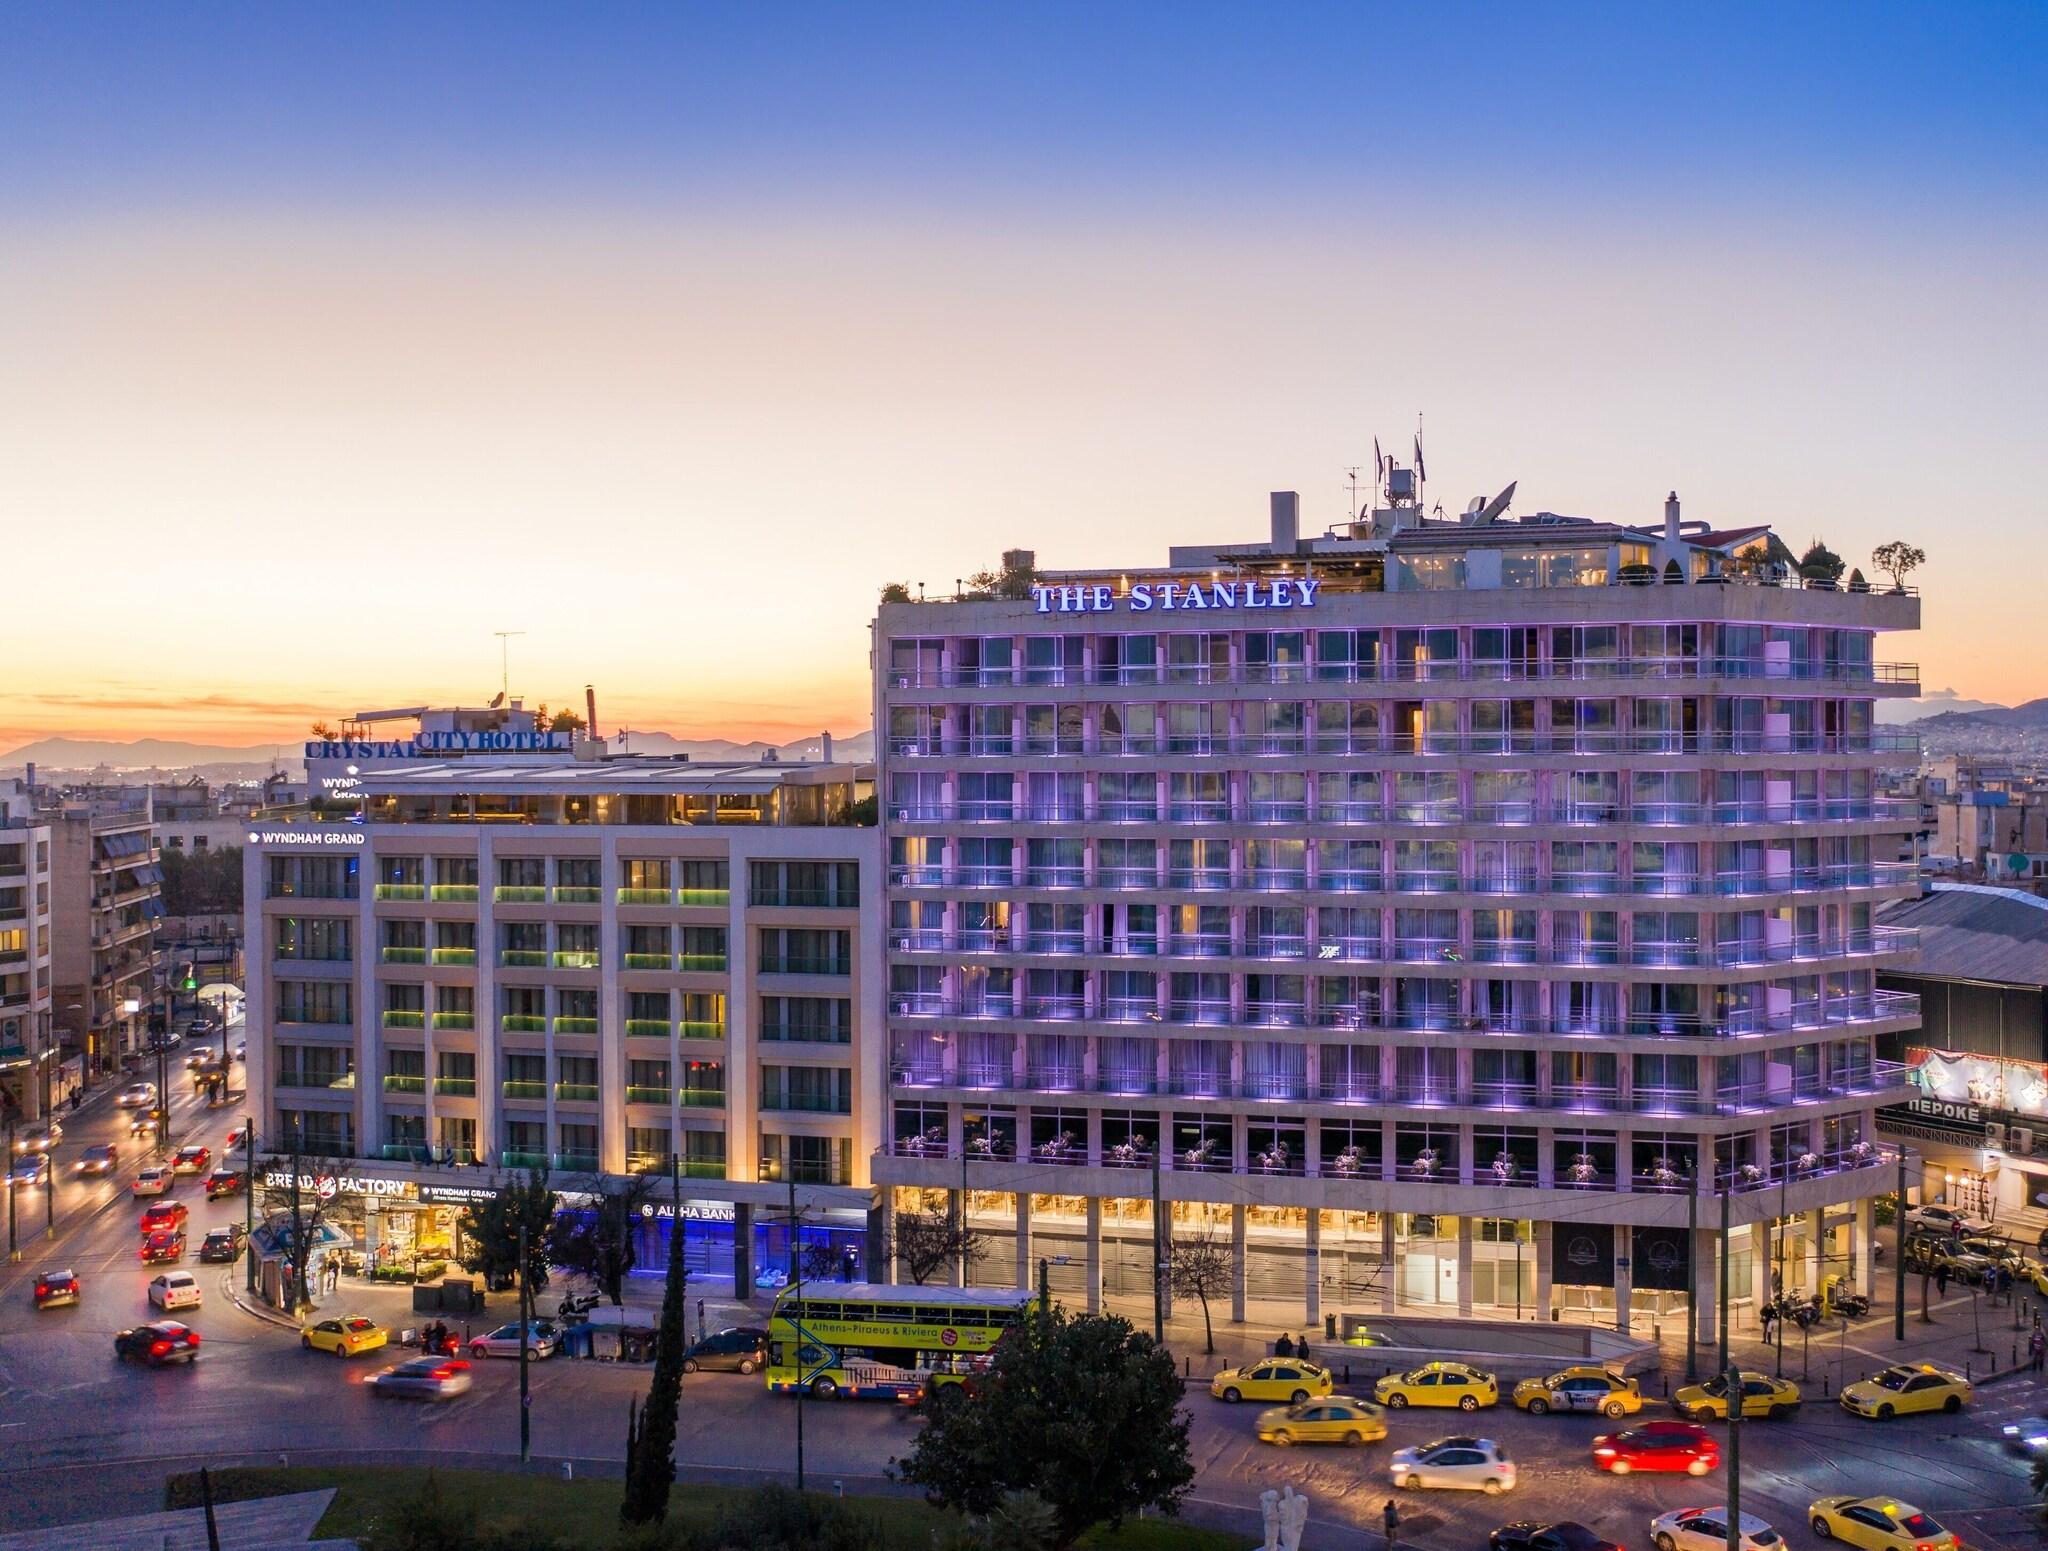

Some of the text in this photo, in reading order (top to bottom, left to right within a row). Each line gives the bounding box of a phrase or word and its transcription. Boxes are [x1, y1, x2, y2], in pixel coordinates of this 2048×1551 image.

[1032, 580, 1320, 612] THE STANLEY
[415, 731, 473, 749] CITY
[478, 731, 562, 749] HOTEL
[262, 832, 365, 845] WYNDHAM GRAND
[338, 1177, 406, 1195] FACTORY
[431, 1187, 469, 1198] WYNDHAM
[657, 1205, 736, 1221] ALHA BANK
[902, 1326, 938, 1337] Riviera
